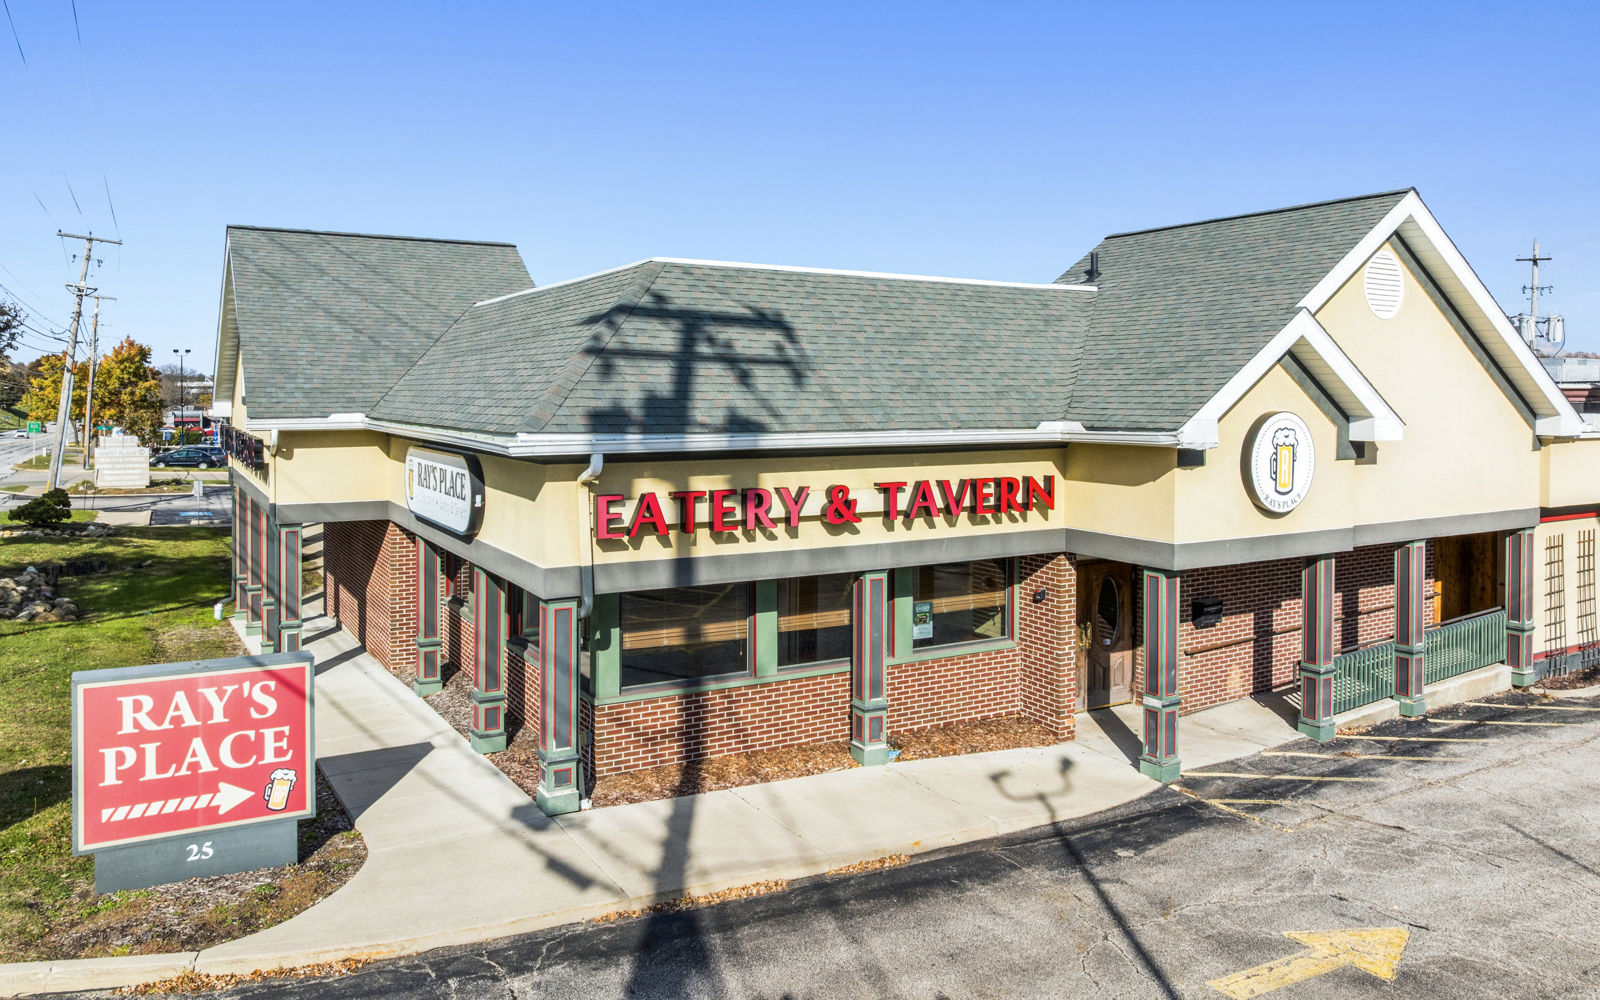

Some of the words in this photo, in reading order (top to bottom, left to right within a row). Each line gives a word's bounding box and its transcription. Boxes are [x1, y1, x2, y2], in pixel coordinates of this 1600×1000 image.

[417, 462, 438, 491] RAY'S
[439, 467, 466, 500] PLACE
[595, 486, 811, 540] EATERY
[822, 484, 862, 525] &
[876, 475, 1055, 521] TAVERN
[117, 680, 277, 735] RAY'S
[99, 725, 293, 787] PLACE
[186, 841, 214, 862] 25
